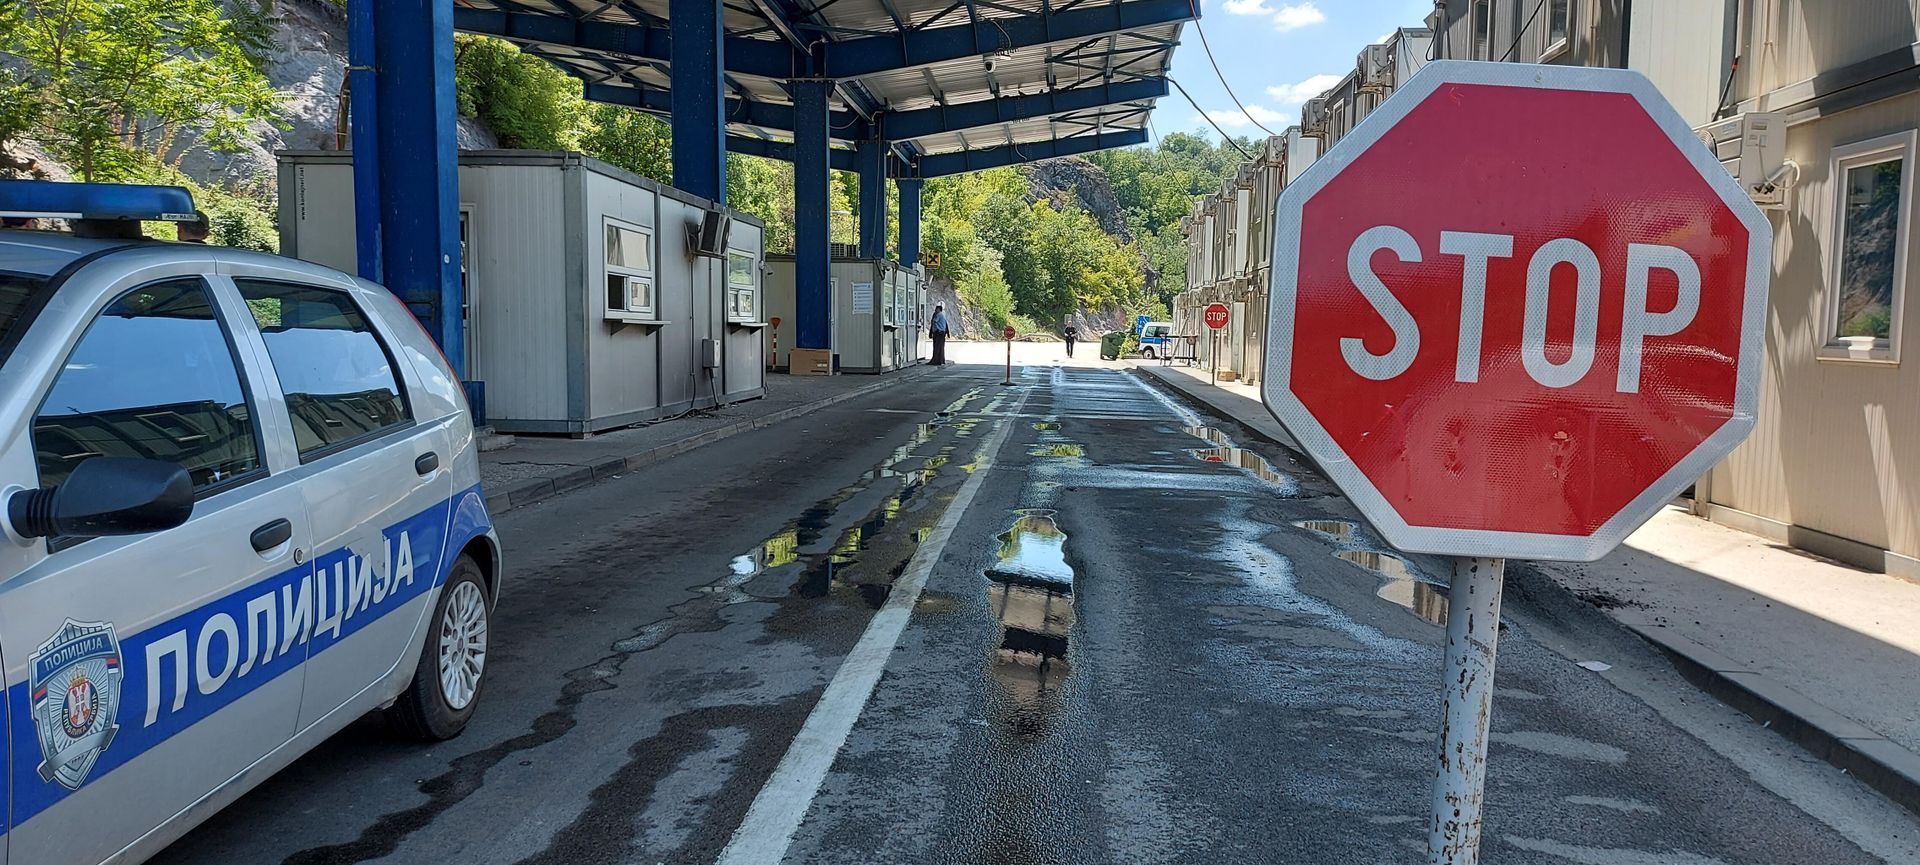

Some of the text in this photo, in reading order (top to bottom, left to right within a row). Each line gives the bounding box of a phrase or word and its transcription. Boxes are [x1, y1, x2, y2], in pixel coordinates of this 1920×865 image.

[1207, 312, 1227, 321] STOP
[1339, 225, 1702, 393] STOP
[45, 638, 103, 671] ПОЛИЦИЈА
[143, 530, 414, 728] ПОЛИЦИЈА
